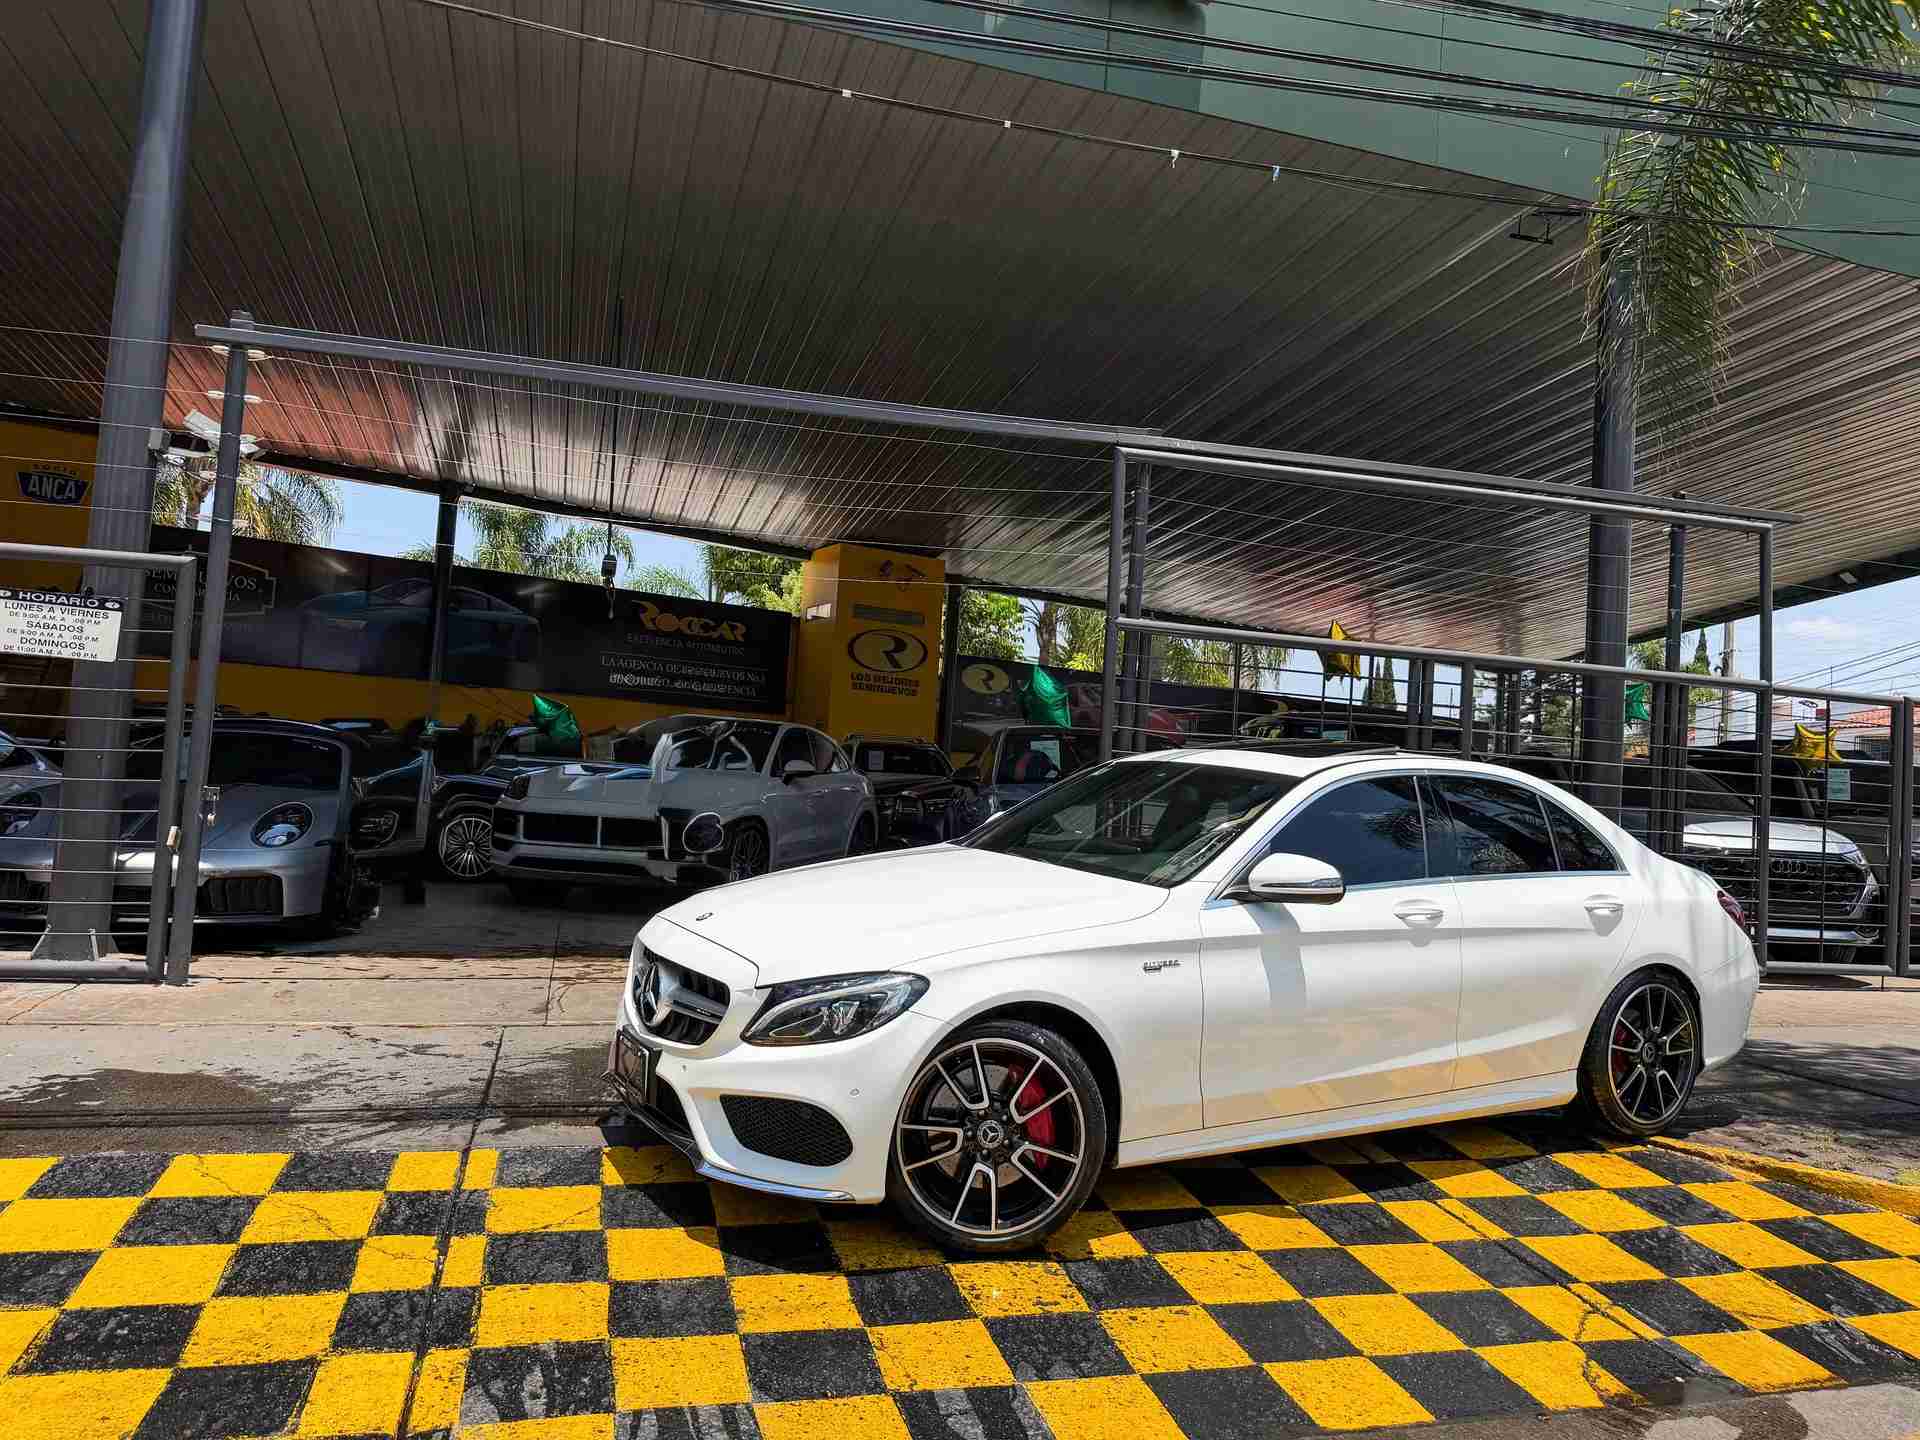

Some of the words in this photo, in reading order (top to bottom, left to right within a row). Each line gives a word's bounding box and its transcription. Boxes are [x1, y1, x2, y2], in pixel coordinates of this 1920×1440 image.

[28, 475, 77, 499] ANCA
[18, 591, 99, 607] HORARIO
[4, 601, 44, 613] LUNES
[47, 606, 55, 614] A
[60, 608, 110, 620] VIERNES
[20, 636, 86, 651] DOMINGOS
[601, 655, 616, 666] LA
[618, 657, 664, 672] AGENCIA
